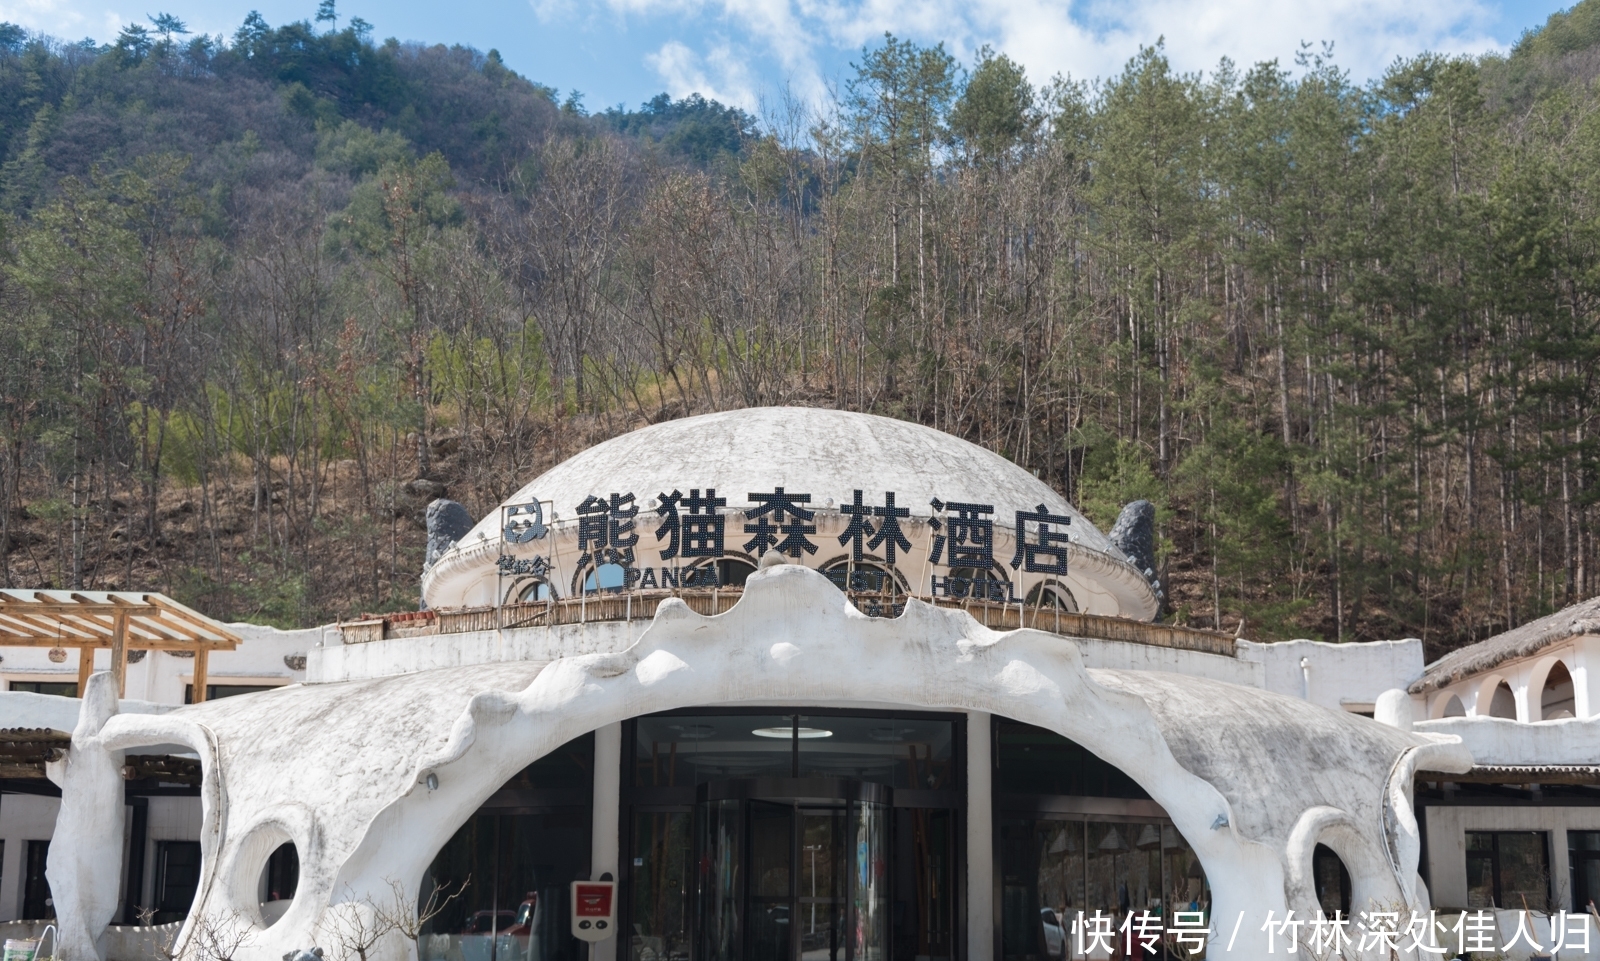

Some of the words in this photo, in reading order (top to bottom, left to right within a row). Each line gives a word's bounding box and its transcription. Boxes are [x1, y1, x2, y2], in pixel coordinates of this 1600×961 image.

[575, 487, 1071, 576] 熊猫森林酒店
[623, 565, 720, 590] PANDA
[818, 569, 889, 593] EST
[930, 574, 1024, 603] HOTEL
